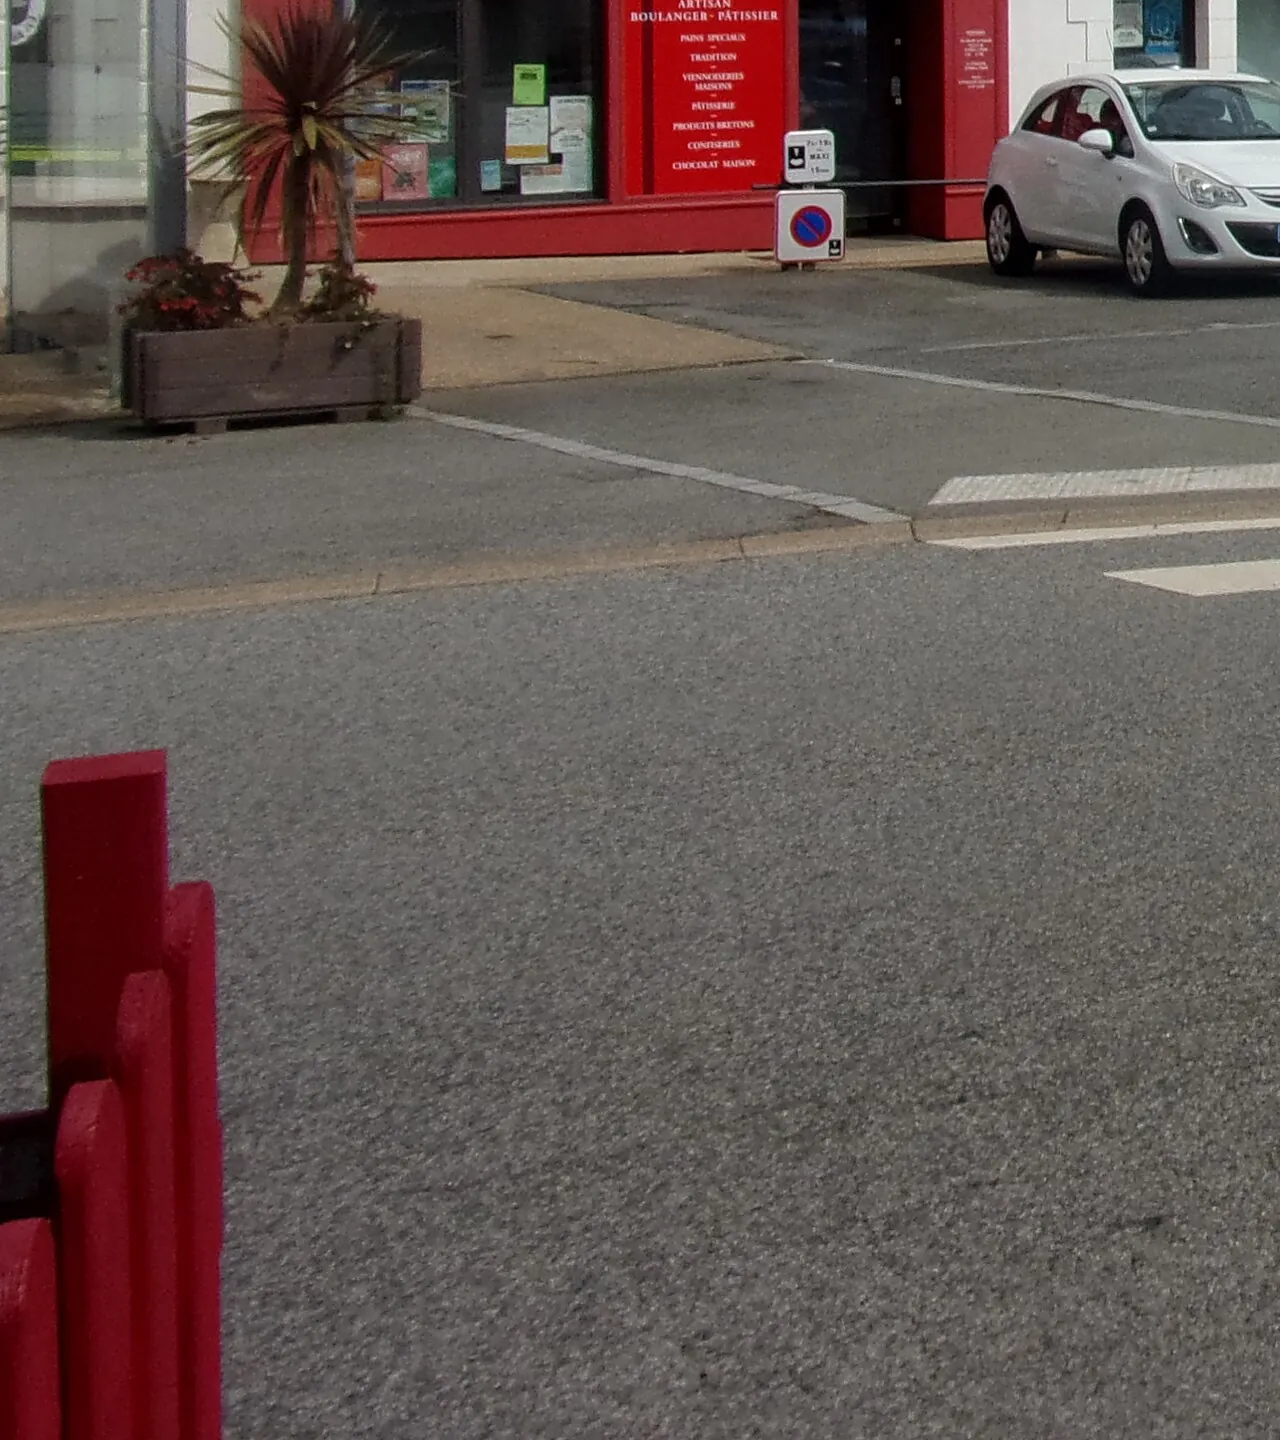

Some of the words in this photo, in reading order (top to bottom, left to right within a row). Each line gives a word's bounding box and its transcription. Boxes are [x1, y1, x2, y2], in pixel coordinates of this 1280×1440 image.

[630, 11, 708, 22] BOULANGER
[690, 53, 737, 62] TRADITION
[672, 122, 715, 131] PRODUITS
[716, 120, 755, 130] BRETONS
[672, 161, 718, 170] CHOCOLAT
[723, 159, 756, 168] MAISON
